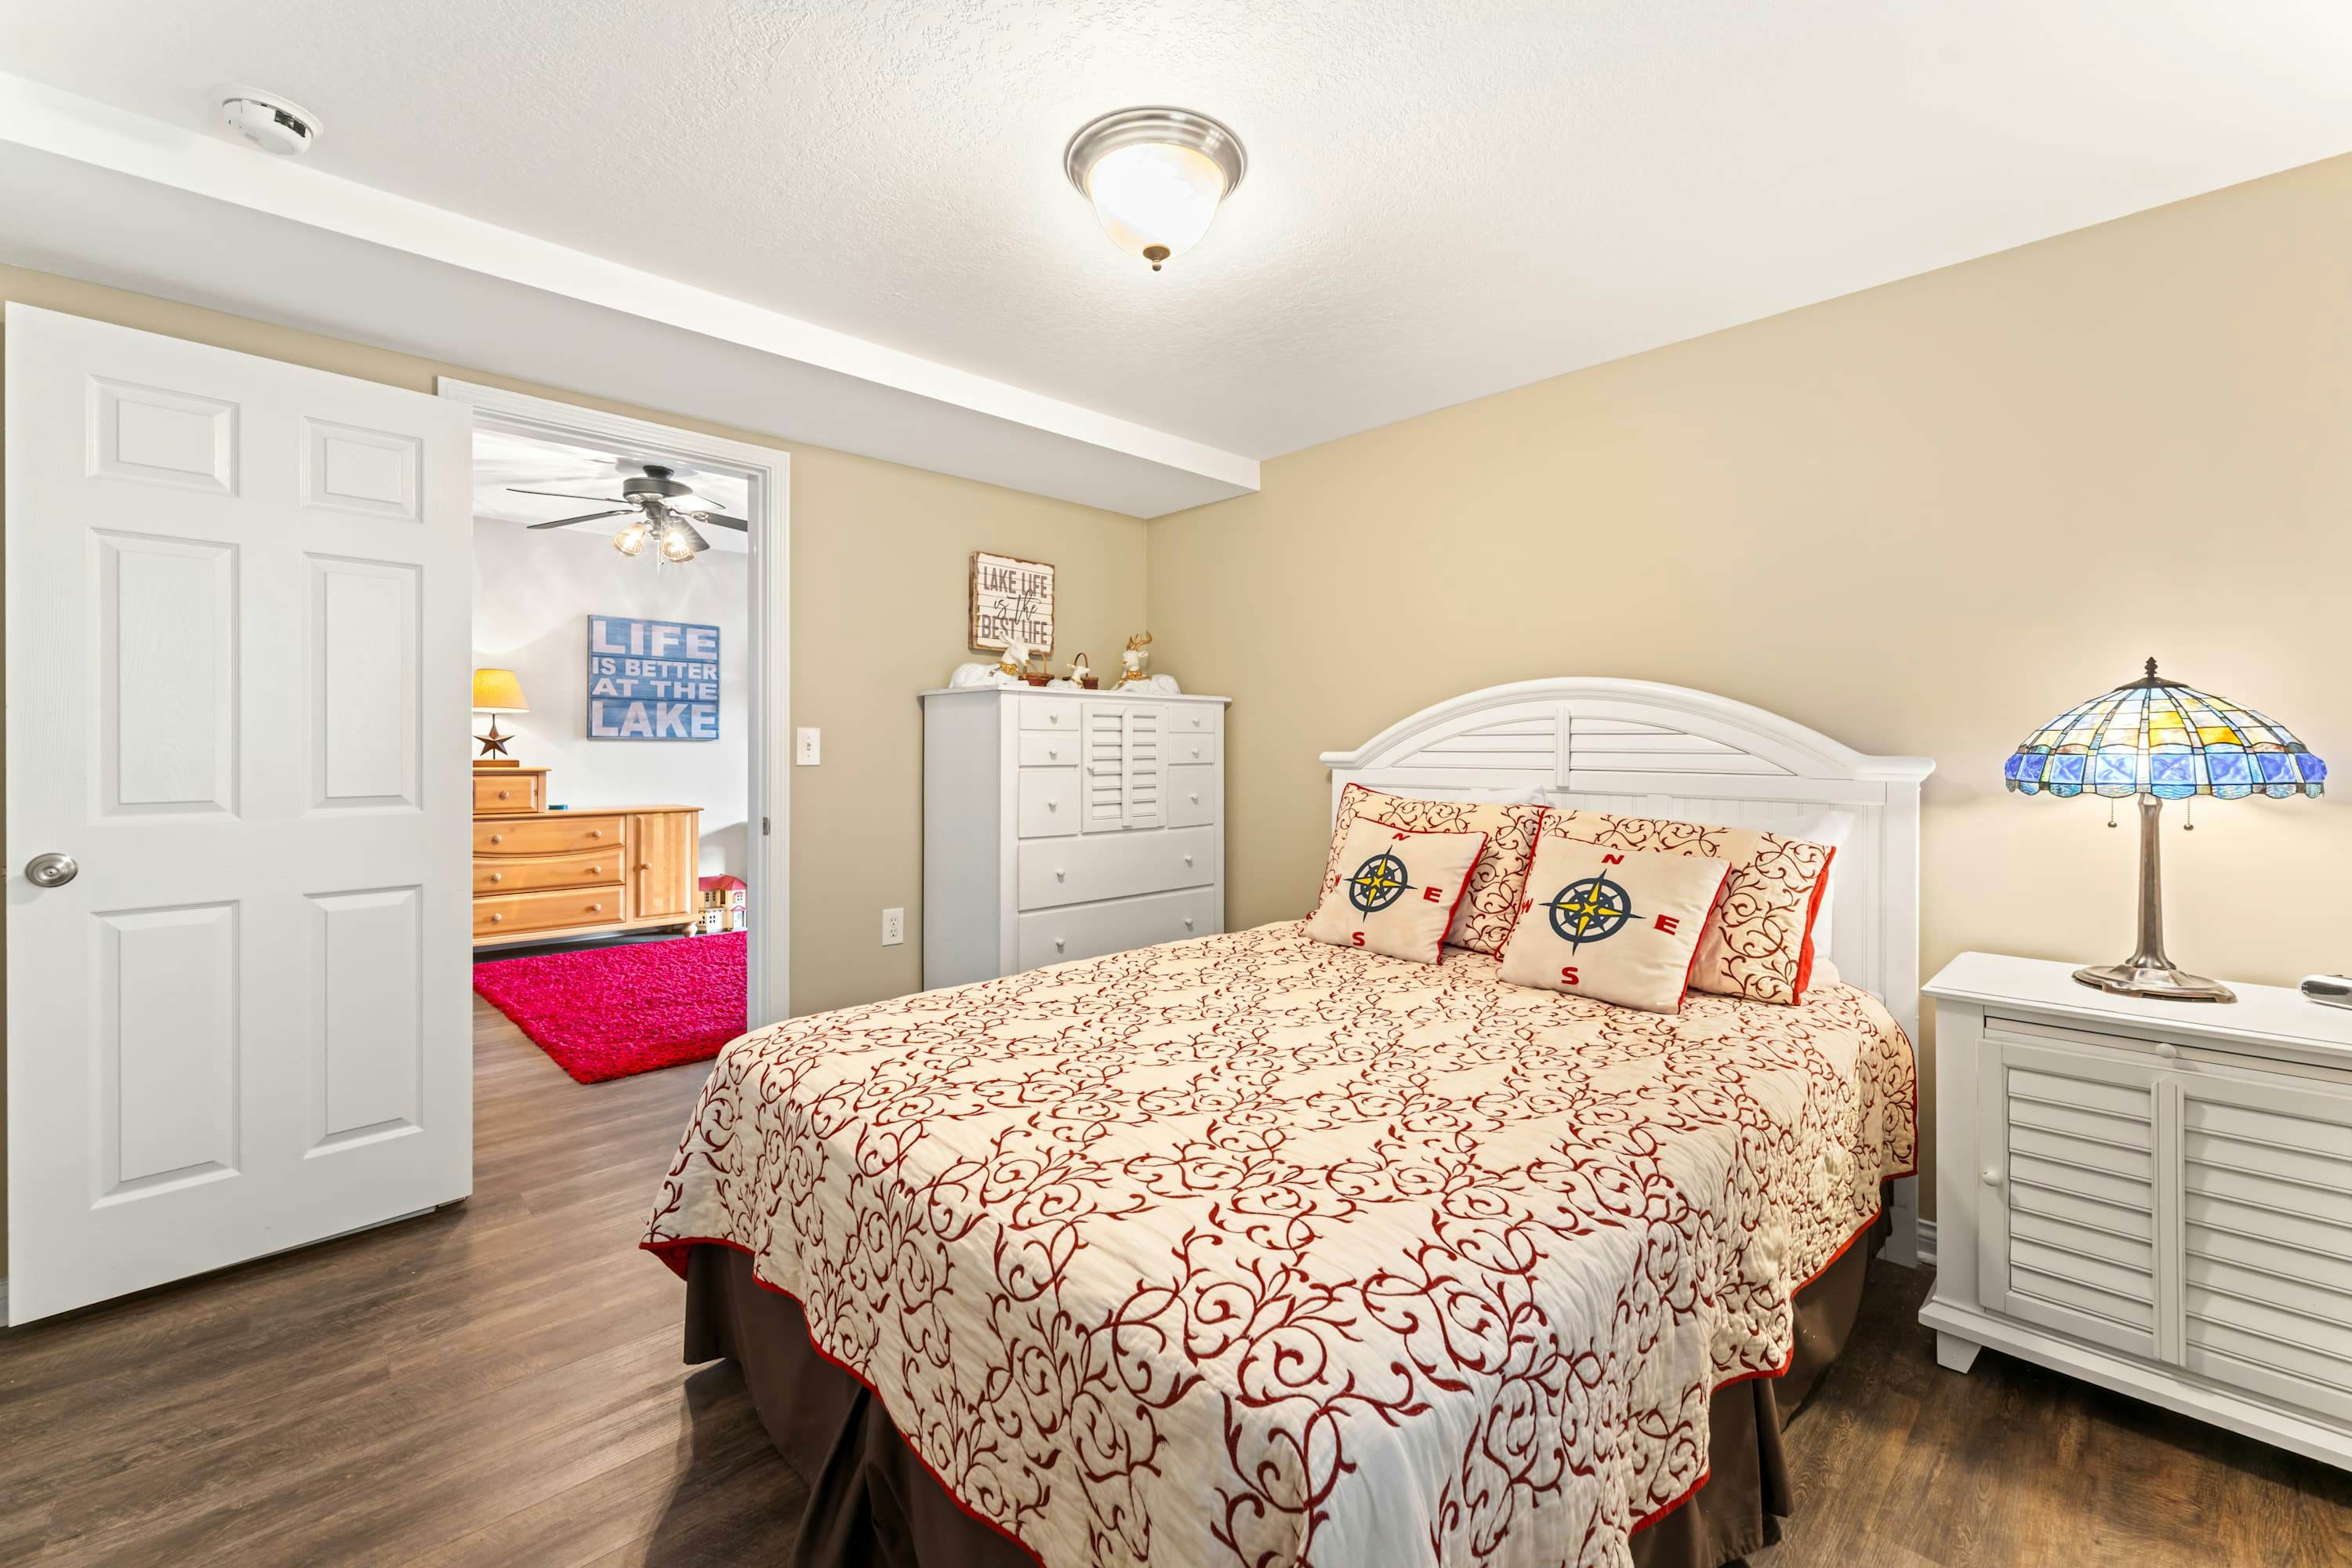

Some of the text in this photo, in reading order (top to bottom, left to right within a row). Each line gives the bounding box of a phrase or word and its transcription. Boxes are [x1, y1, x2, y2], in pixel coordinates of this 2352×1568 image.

[984, 566, 1047, 598] LAKE LIFE
[994, 599, 1010, 619] is
[592, 620, 717, 660] LIFE
[982, 615, 1047, 644] BEST LIFE
[592, 657, 717, 680] IS BETTER
[591, 678, 717, 700] AT THE
[591, 701, 717, 739] LAKE
[1392, 833, 1410, 841] N
[1601, 854, 1625, 865] N
[1423, 886, 1443, 903] E
[1653, 914, 1680, 936] E
[1352, 931, 1366, 947] S
[1561, 967, 1579, 985] S
